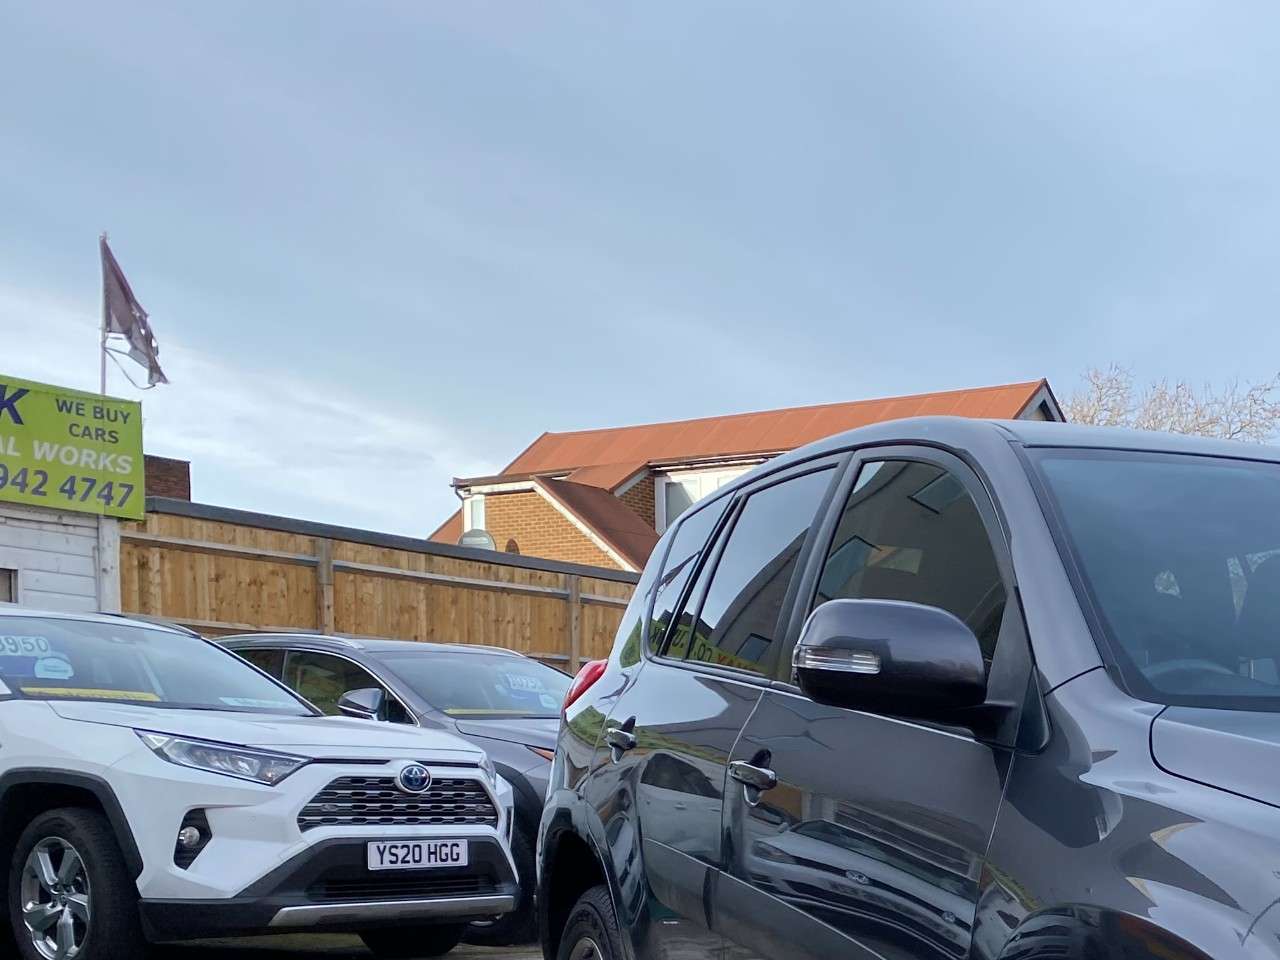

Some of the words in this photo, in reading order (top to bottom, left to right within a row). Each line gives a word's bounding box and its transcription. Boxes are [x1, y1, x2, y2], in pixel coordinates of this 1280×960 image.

[56, 399, 86, 416] WE
[93, 405, 130, 424] BUY
[68, 423, 119, 444] CARS
[32, 440, 133, 474] WORKS
[59, 475, 134, 508] 4747
[376, 844, 422, 865] YS20
[427, 843, 460, 863] HGG
